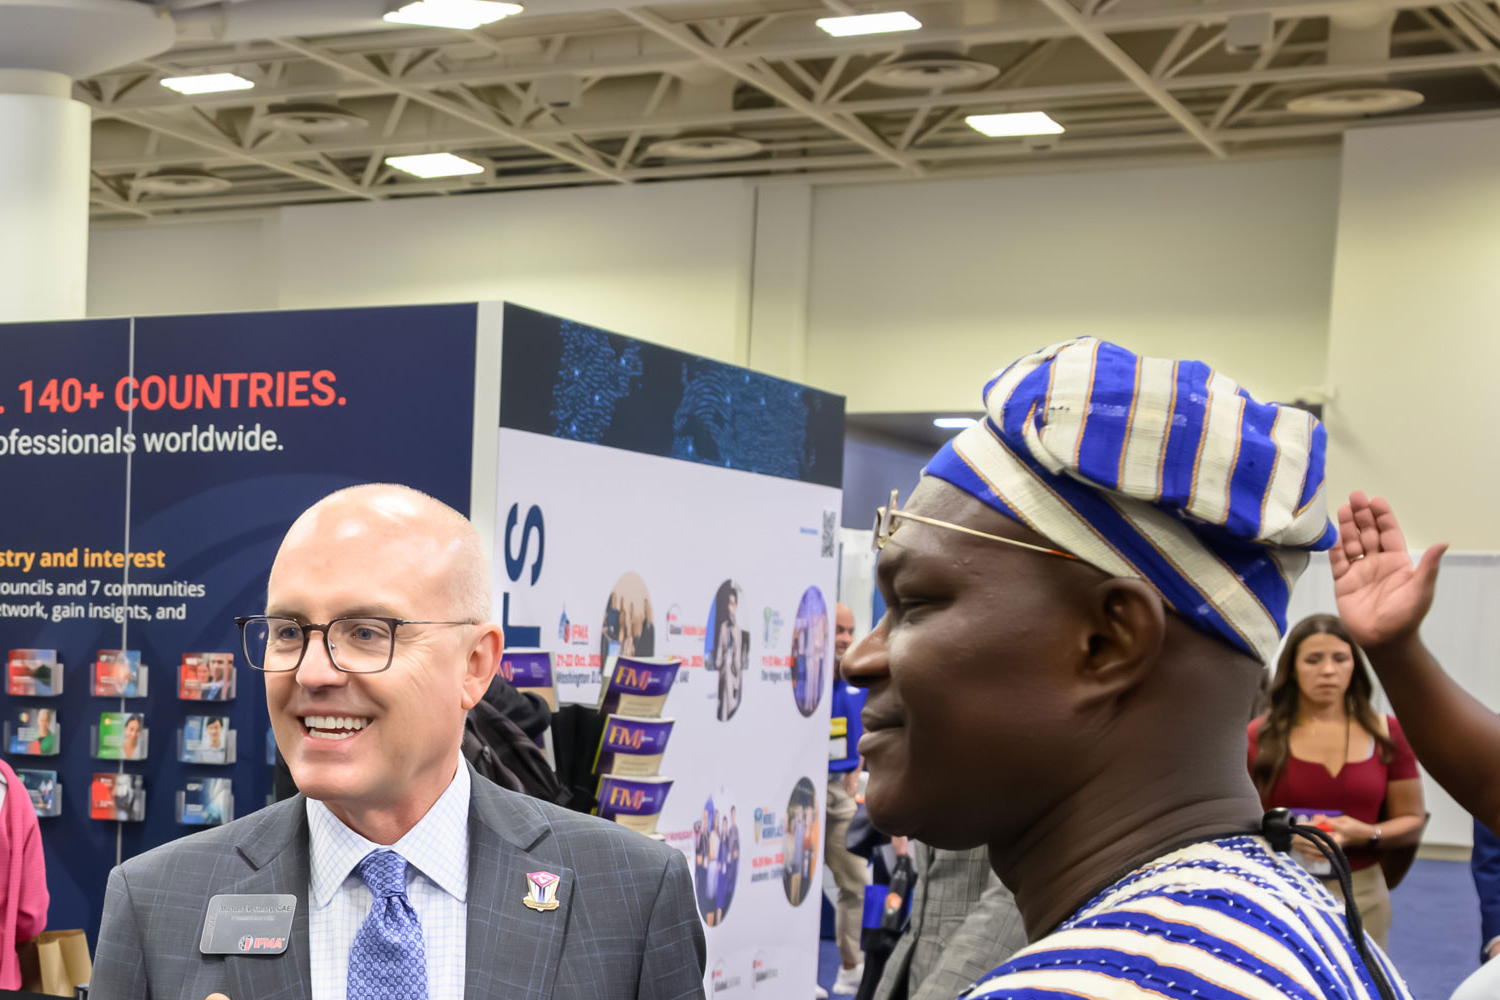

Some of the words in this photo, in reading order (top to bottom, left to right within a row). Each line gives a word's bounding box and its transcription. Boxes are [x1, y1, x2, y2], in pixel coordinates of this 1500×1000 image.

[18, 378, 104, 413] 140+
[115, 370, 346, 411] COUNTRIES.
[143, 423, 283, 453] worldwide.
[40, 548, 78, 568] and
[84, 548, 166, 568] interest
[57, 579, 87, 596] and
[90, 580, 101, 596] 7
[103, 580, 206, 597] communities
[51, 602, 85, 623] gain
[88, 602, 152, 624] insights,
[155, 603, 186, 620] and
[254, 937, 282, 949] IFMA
